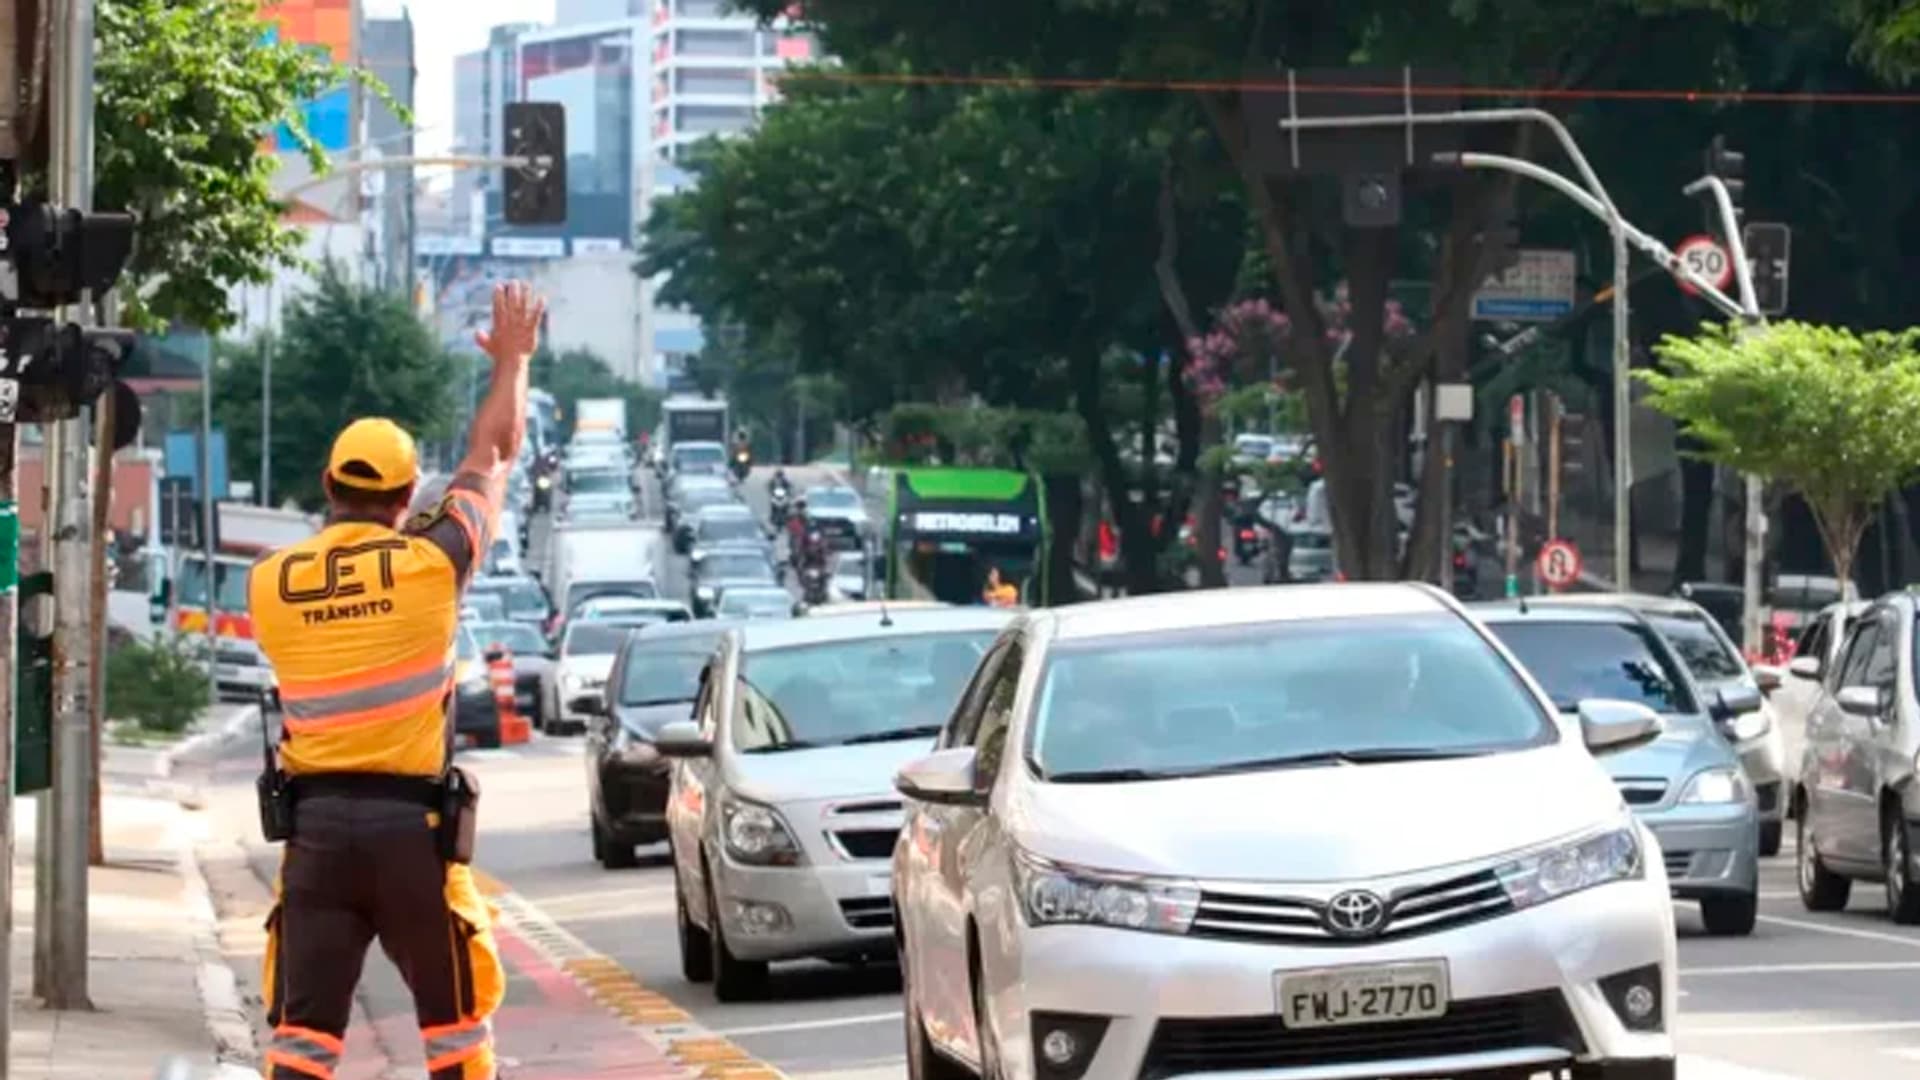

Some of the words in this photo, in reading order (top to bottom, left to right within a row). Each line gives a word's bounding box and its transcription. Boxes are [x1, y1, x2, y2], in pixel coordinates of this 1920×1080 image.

[1687, 250, 1723, 275] 50
[279, 540, 408, 604] CET
[302, 598, 393, 625] TRÂNSITO
